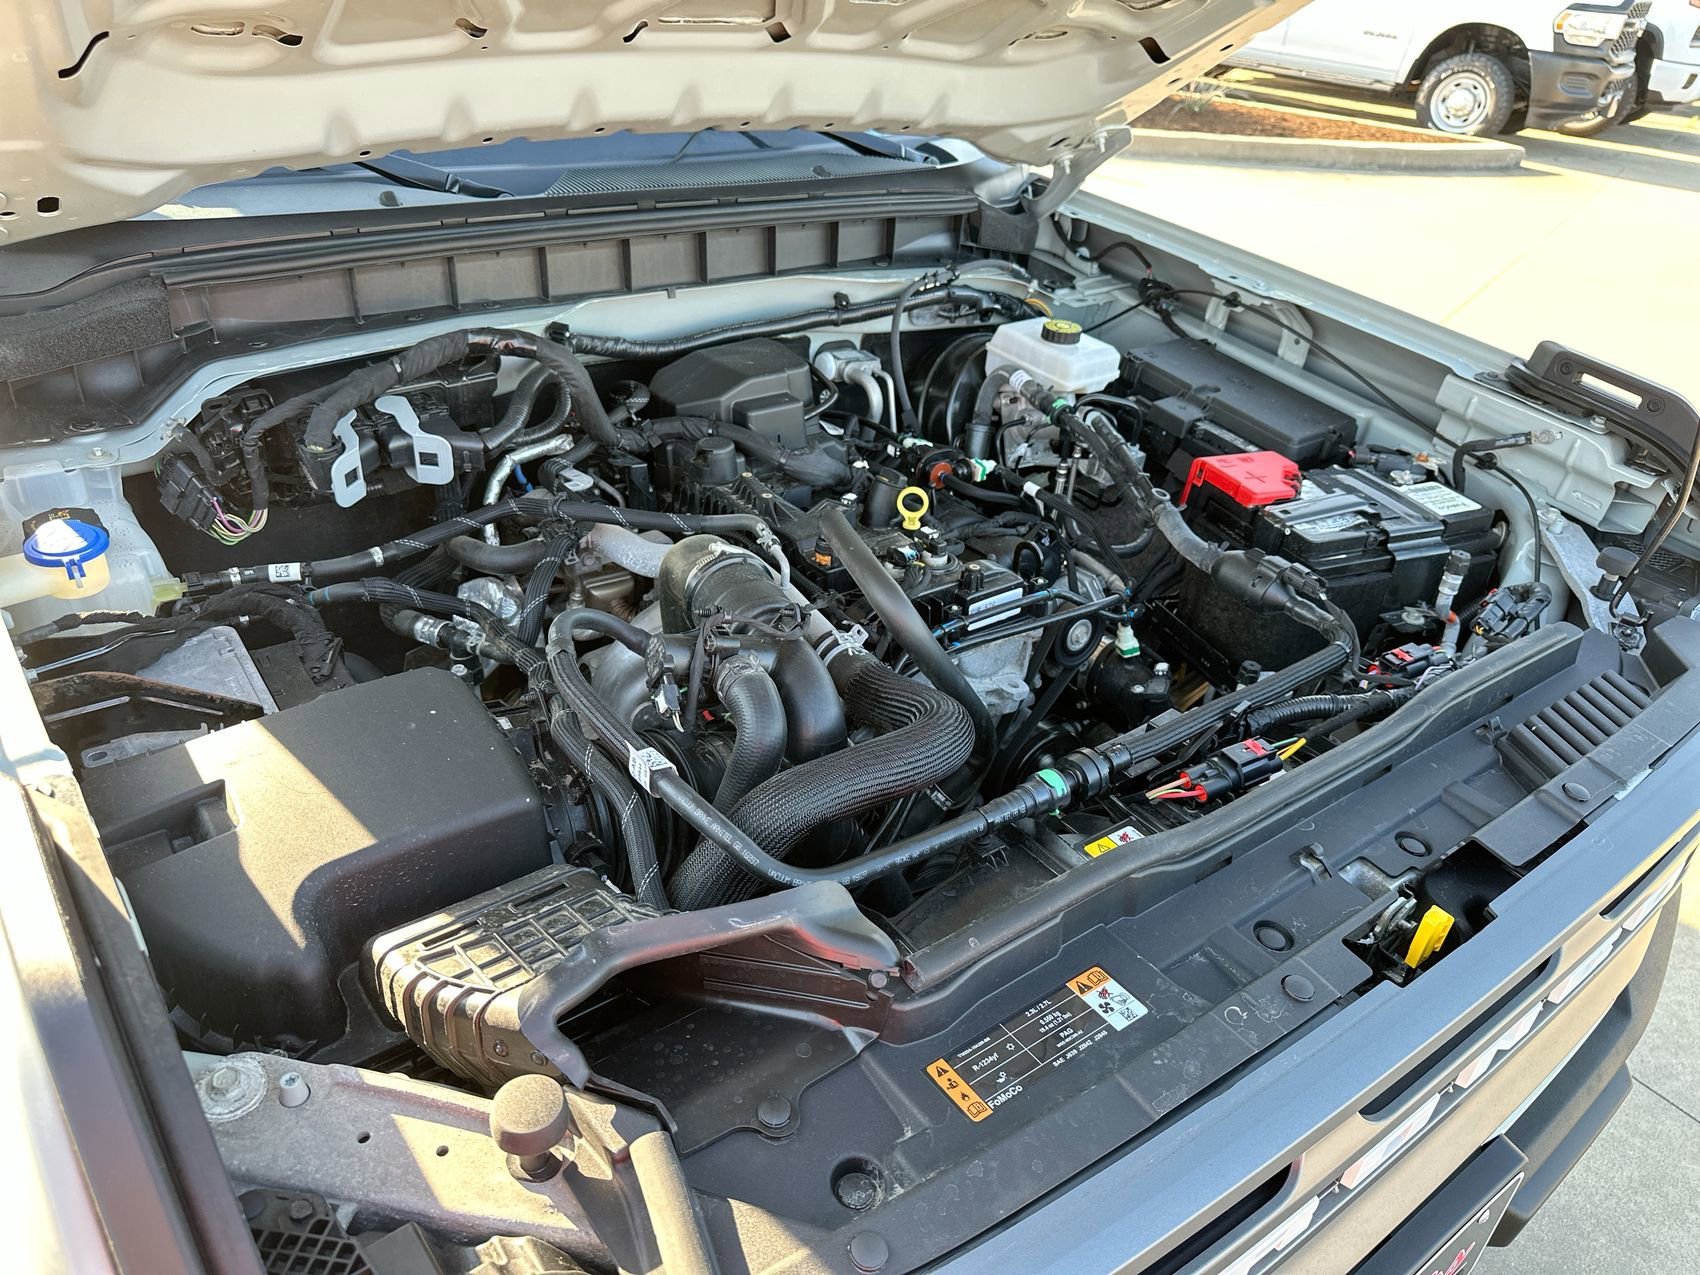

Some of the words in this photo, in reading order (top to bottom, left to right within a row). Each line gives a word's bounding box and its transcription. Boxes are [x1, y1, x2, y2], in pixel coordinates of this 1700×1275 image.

[1025, 1008, 1038, 1017] 2.3L
[1040, 999, 1052, 1009] 2.7L
[1059, 1026, 1073, 1038] PAG
[988, 1085, 1022, 1109] FoMoCo
